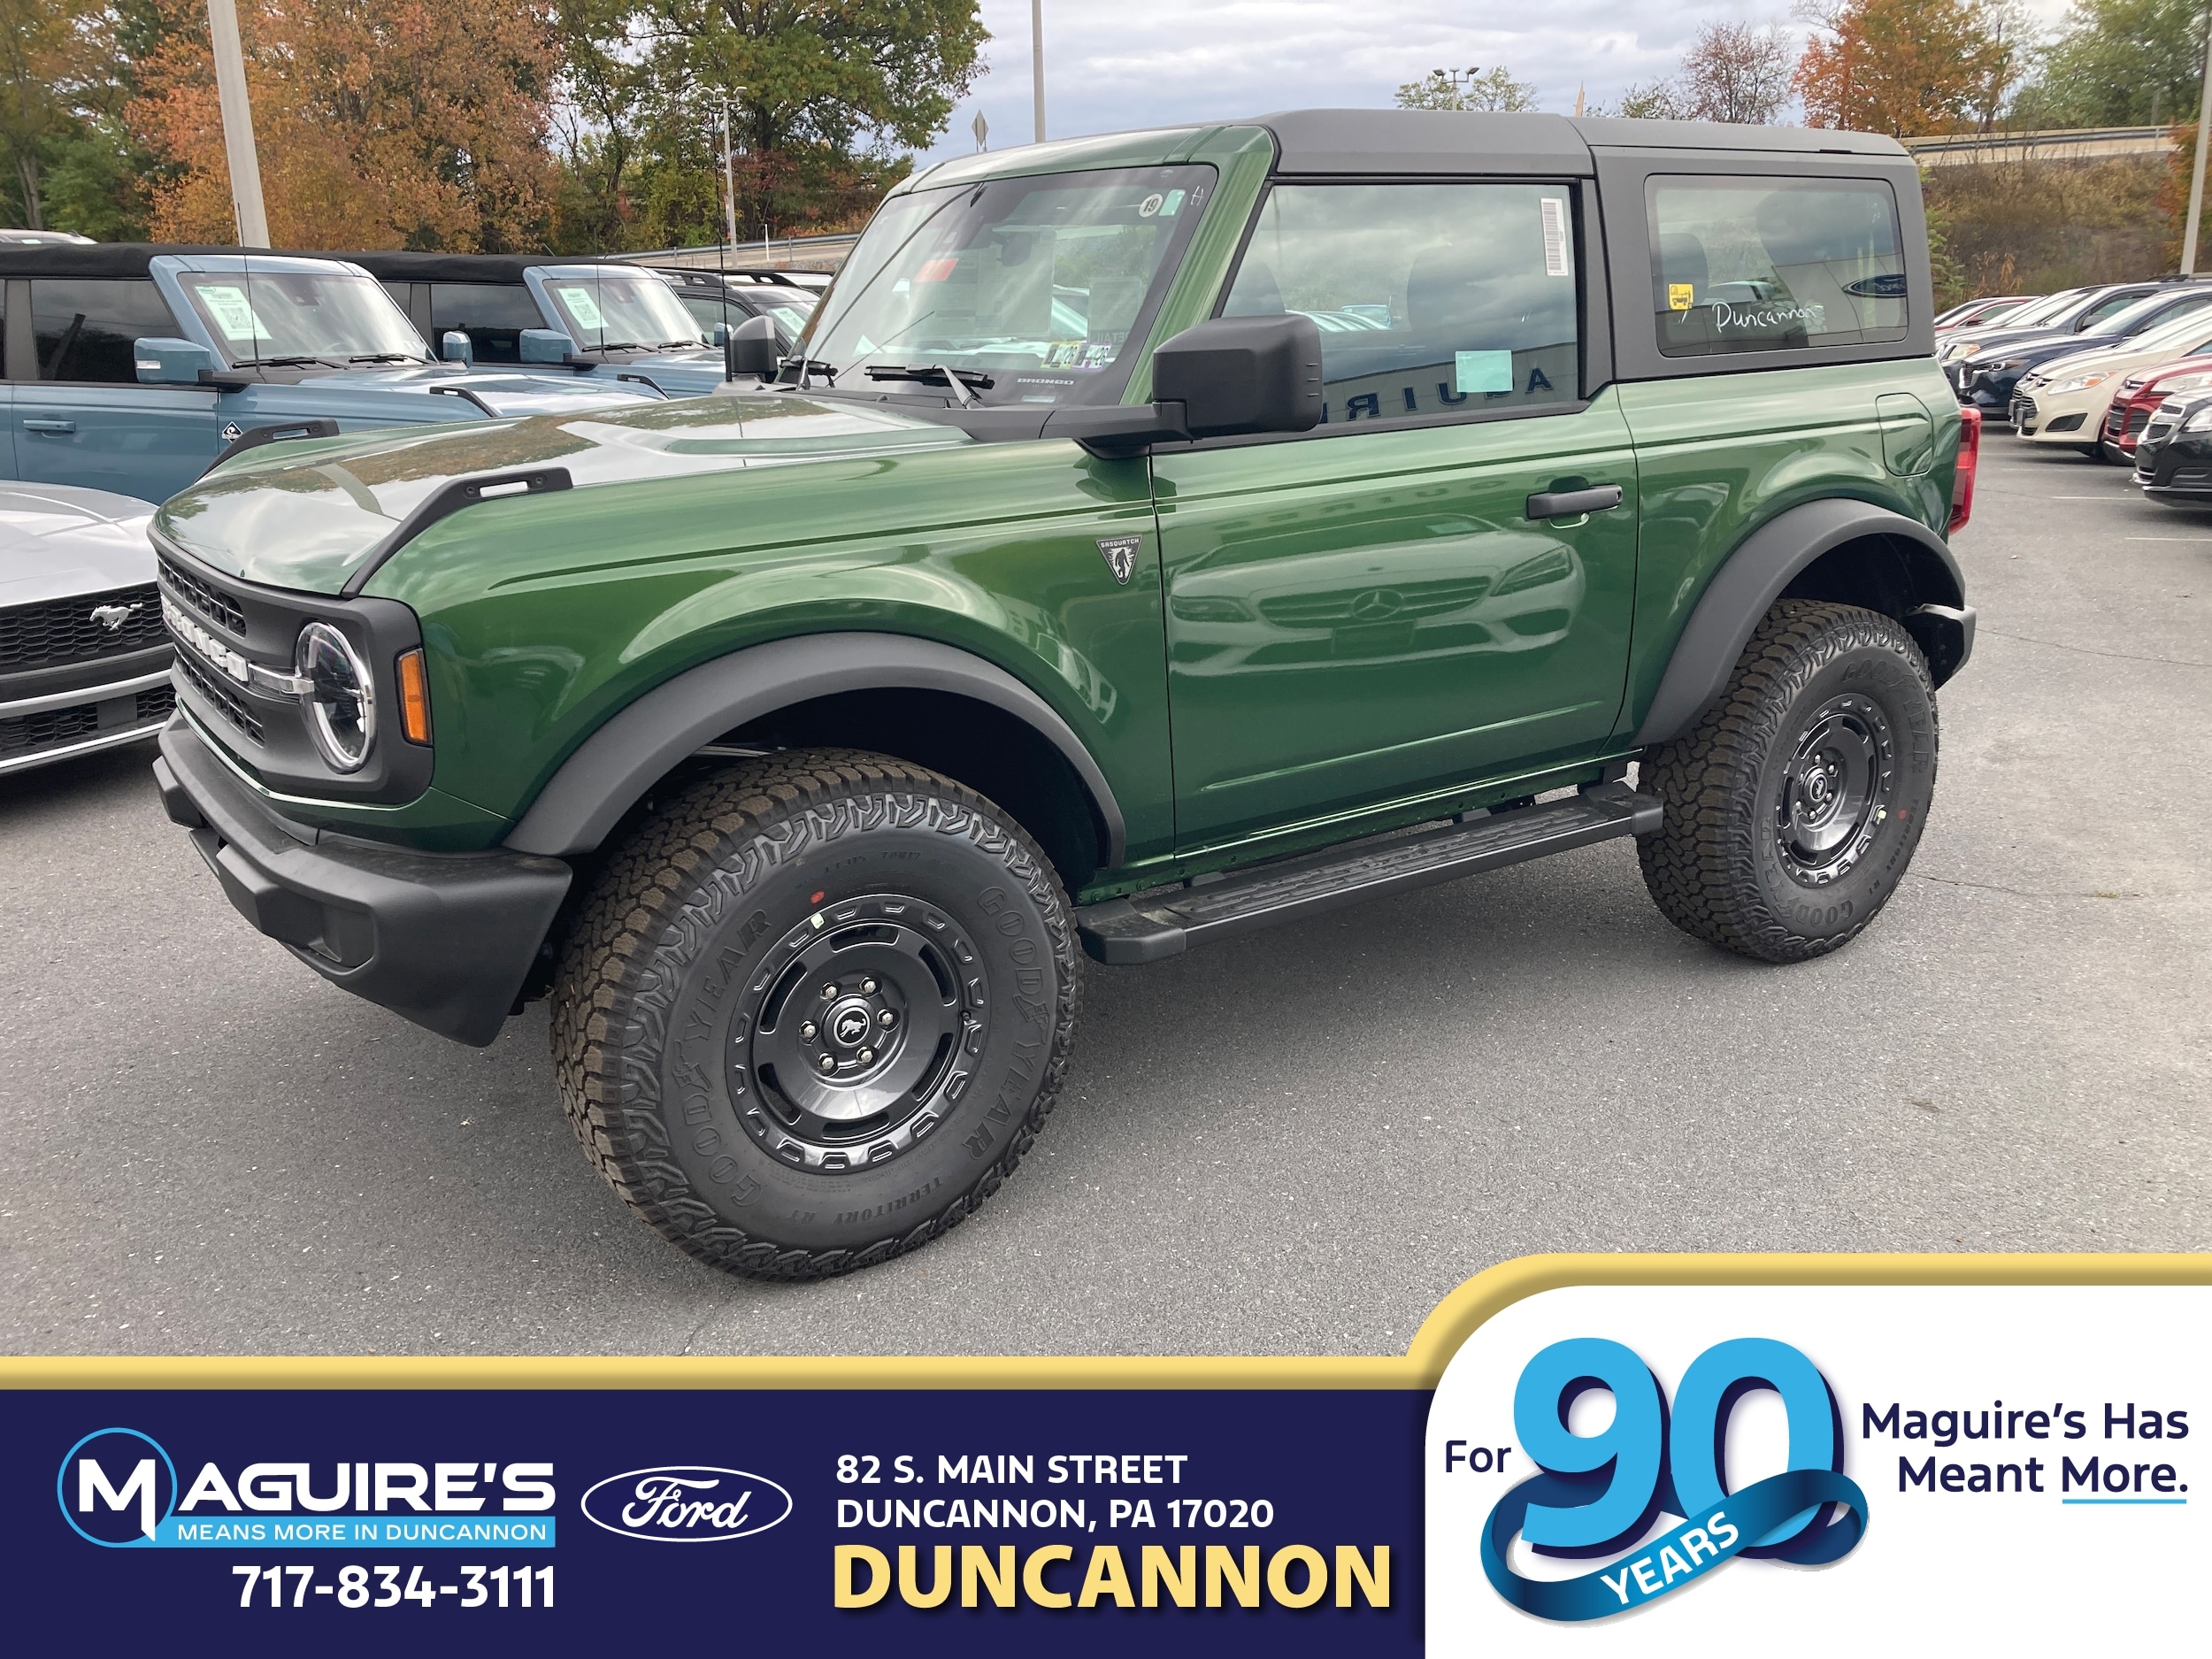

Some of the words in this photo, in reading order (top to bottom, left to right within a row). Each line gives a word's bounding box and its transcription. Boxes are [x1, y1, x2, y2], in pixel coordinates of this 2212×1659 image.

[1143, 197, 1160, 212] 19
[1711, 301, 1816, 334] Duncannon
[1100, 537, 1140, 549] SASQUATCH
[159, 591, 249, 682] BRONCO
[833, 1176, 943, 1225] TERRITORY
